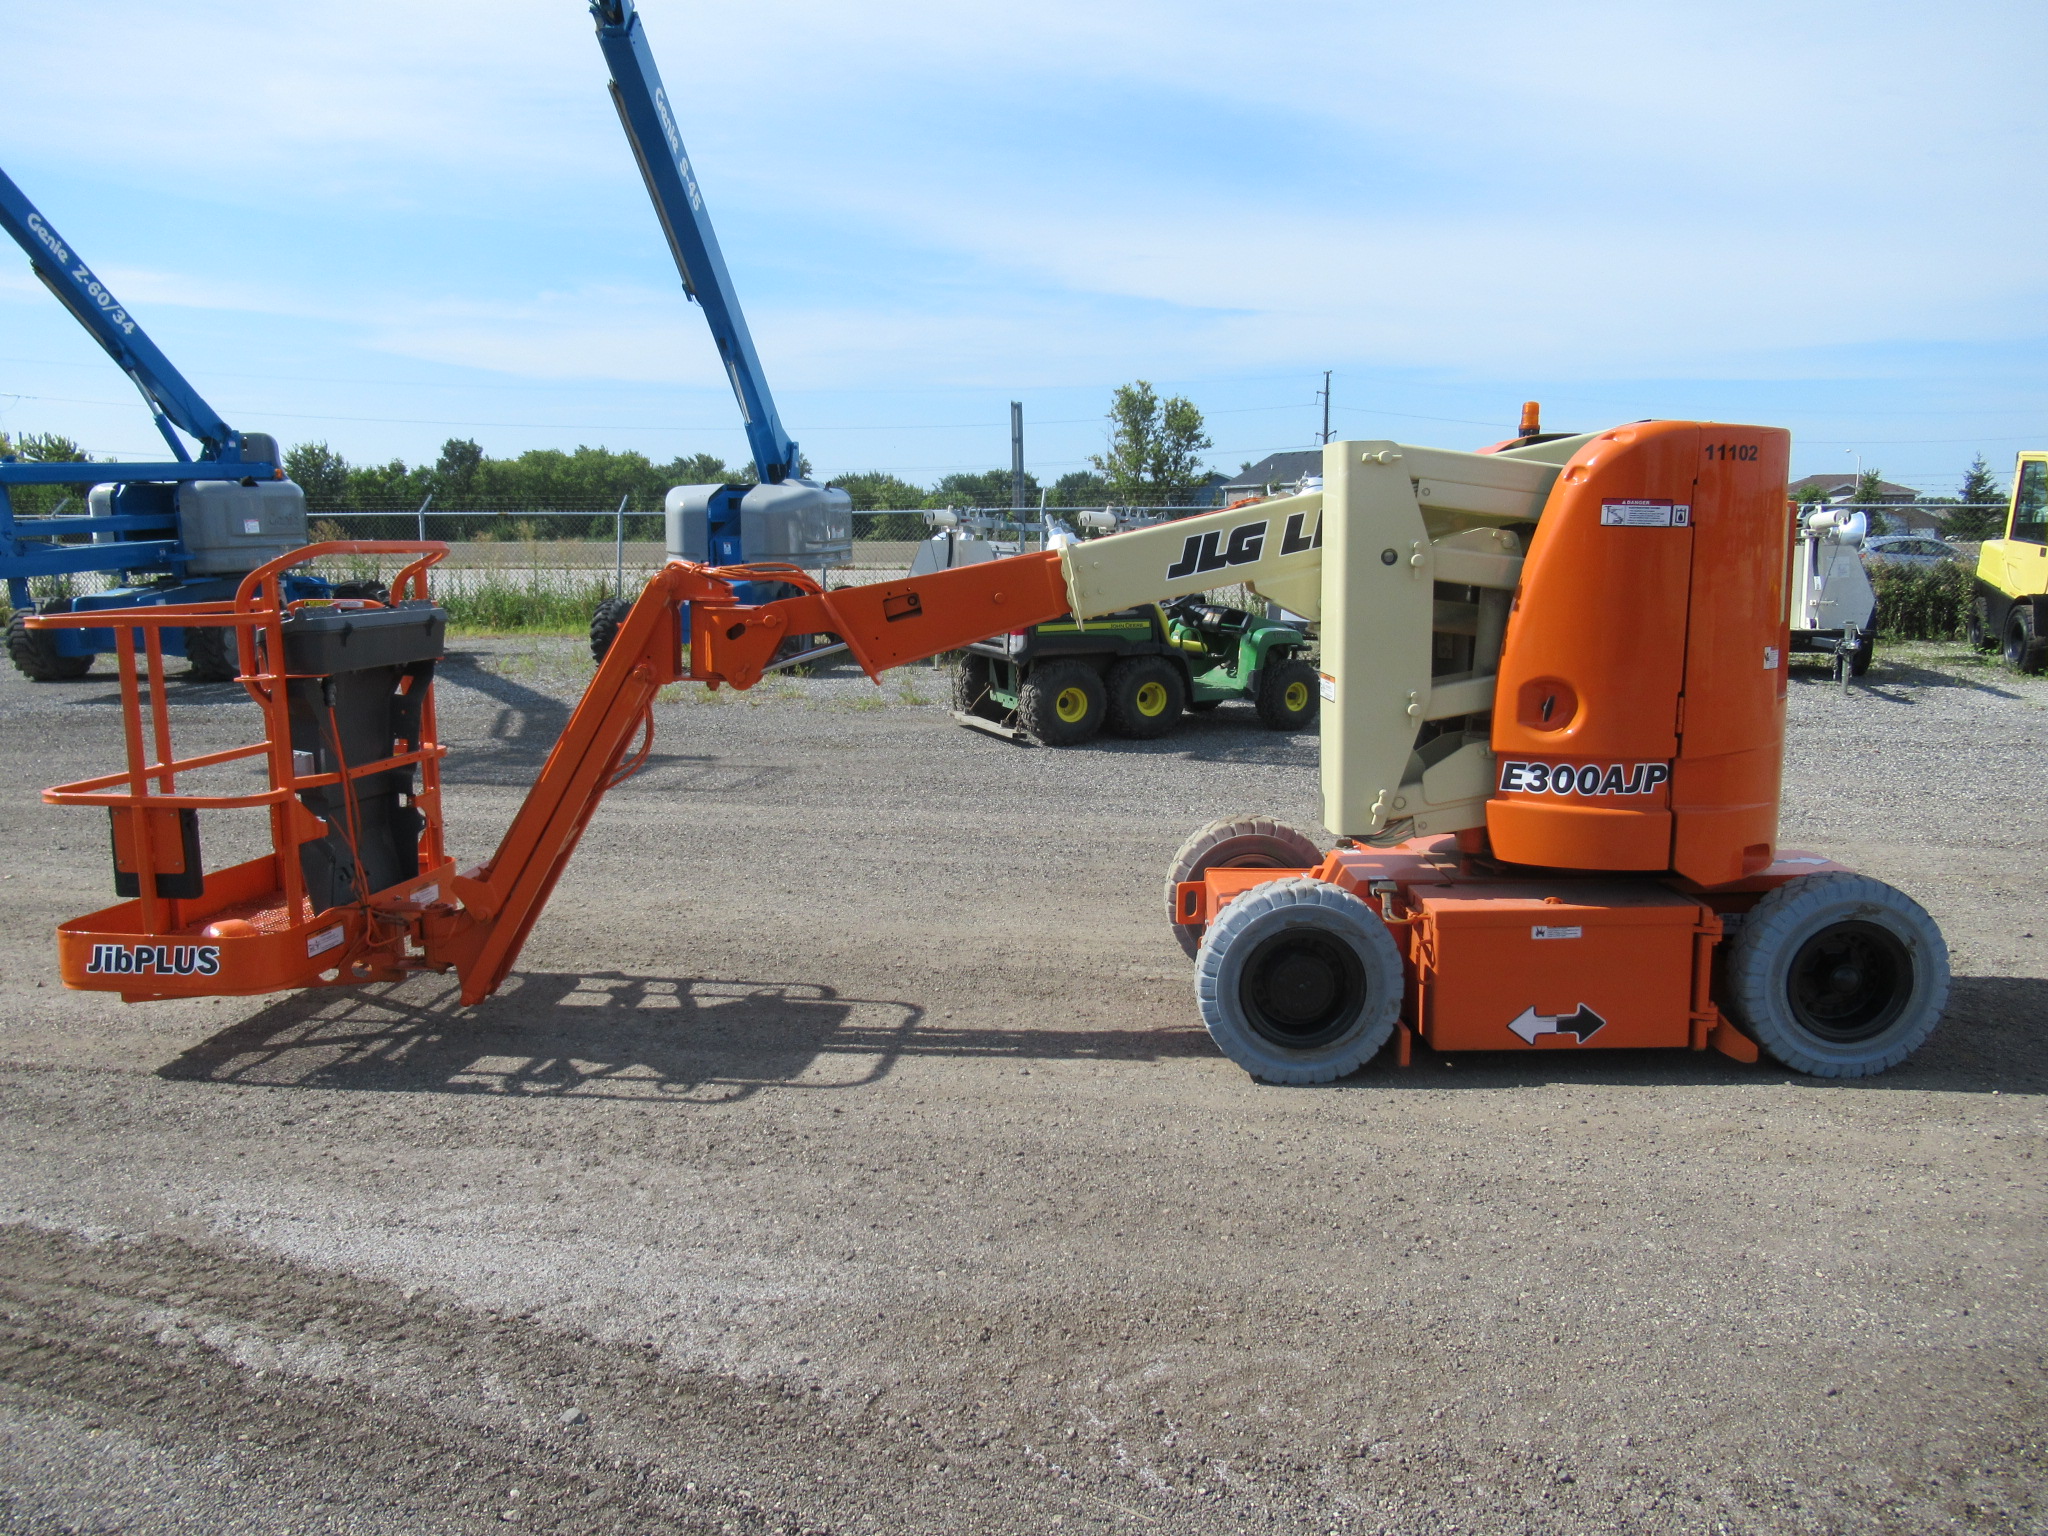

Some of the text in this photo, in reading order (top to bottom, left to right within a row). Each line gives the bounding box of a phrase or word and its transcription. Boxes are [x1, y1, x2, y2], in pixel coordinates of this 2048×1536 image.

[655, 87, 702, 211] Genie S-45
[27, 213, 135, 335] Genie Z-60/34
[1705, 444, 1758, 461] 11102
[1166, 519, 1270, 581] JLG
[1499, 761, 1668, 796] E300AJP
[86, 944, 220, 975] JibPLUS
